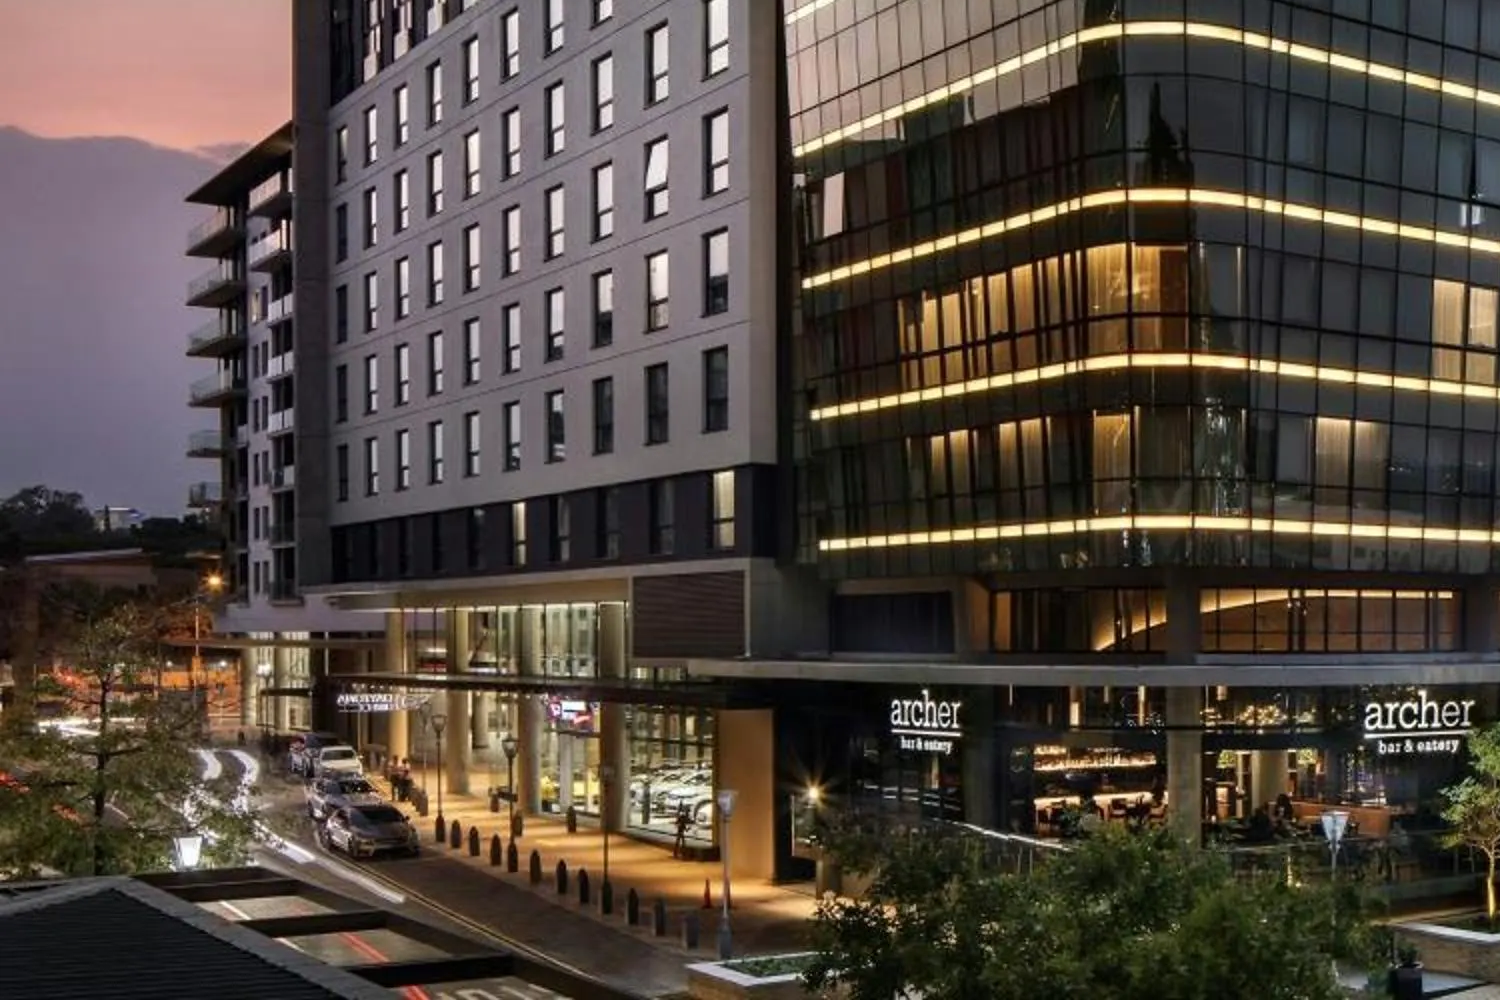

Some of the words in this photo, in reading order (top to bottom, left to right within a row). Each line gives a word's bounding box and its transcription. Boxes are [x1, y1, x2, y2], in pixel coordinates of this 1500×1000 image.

[891, 689, 962, 728] archer
[1364, 690, 1475, 730] archer
[1379, 740, 1401, 754] bar
[1404, 739, 1413, 753] &
[1417, 739, 1459, 753] eatery
